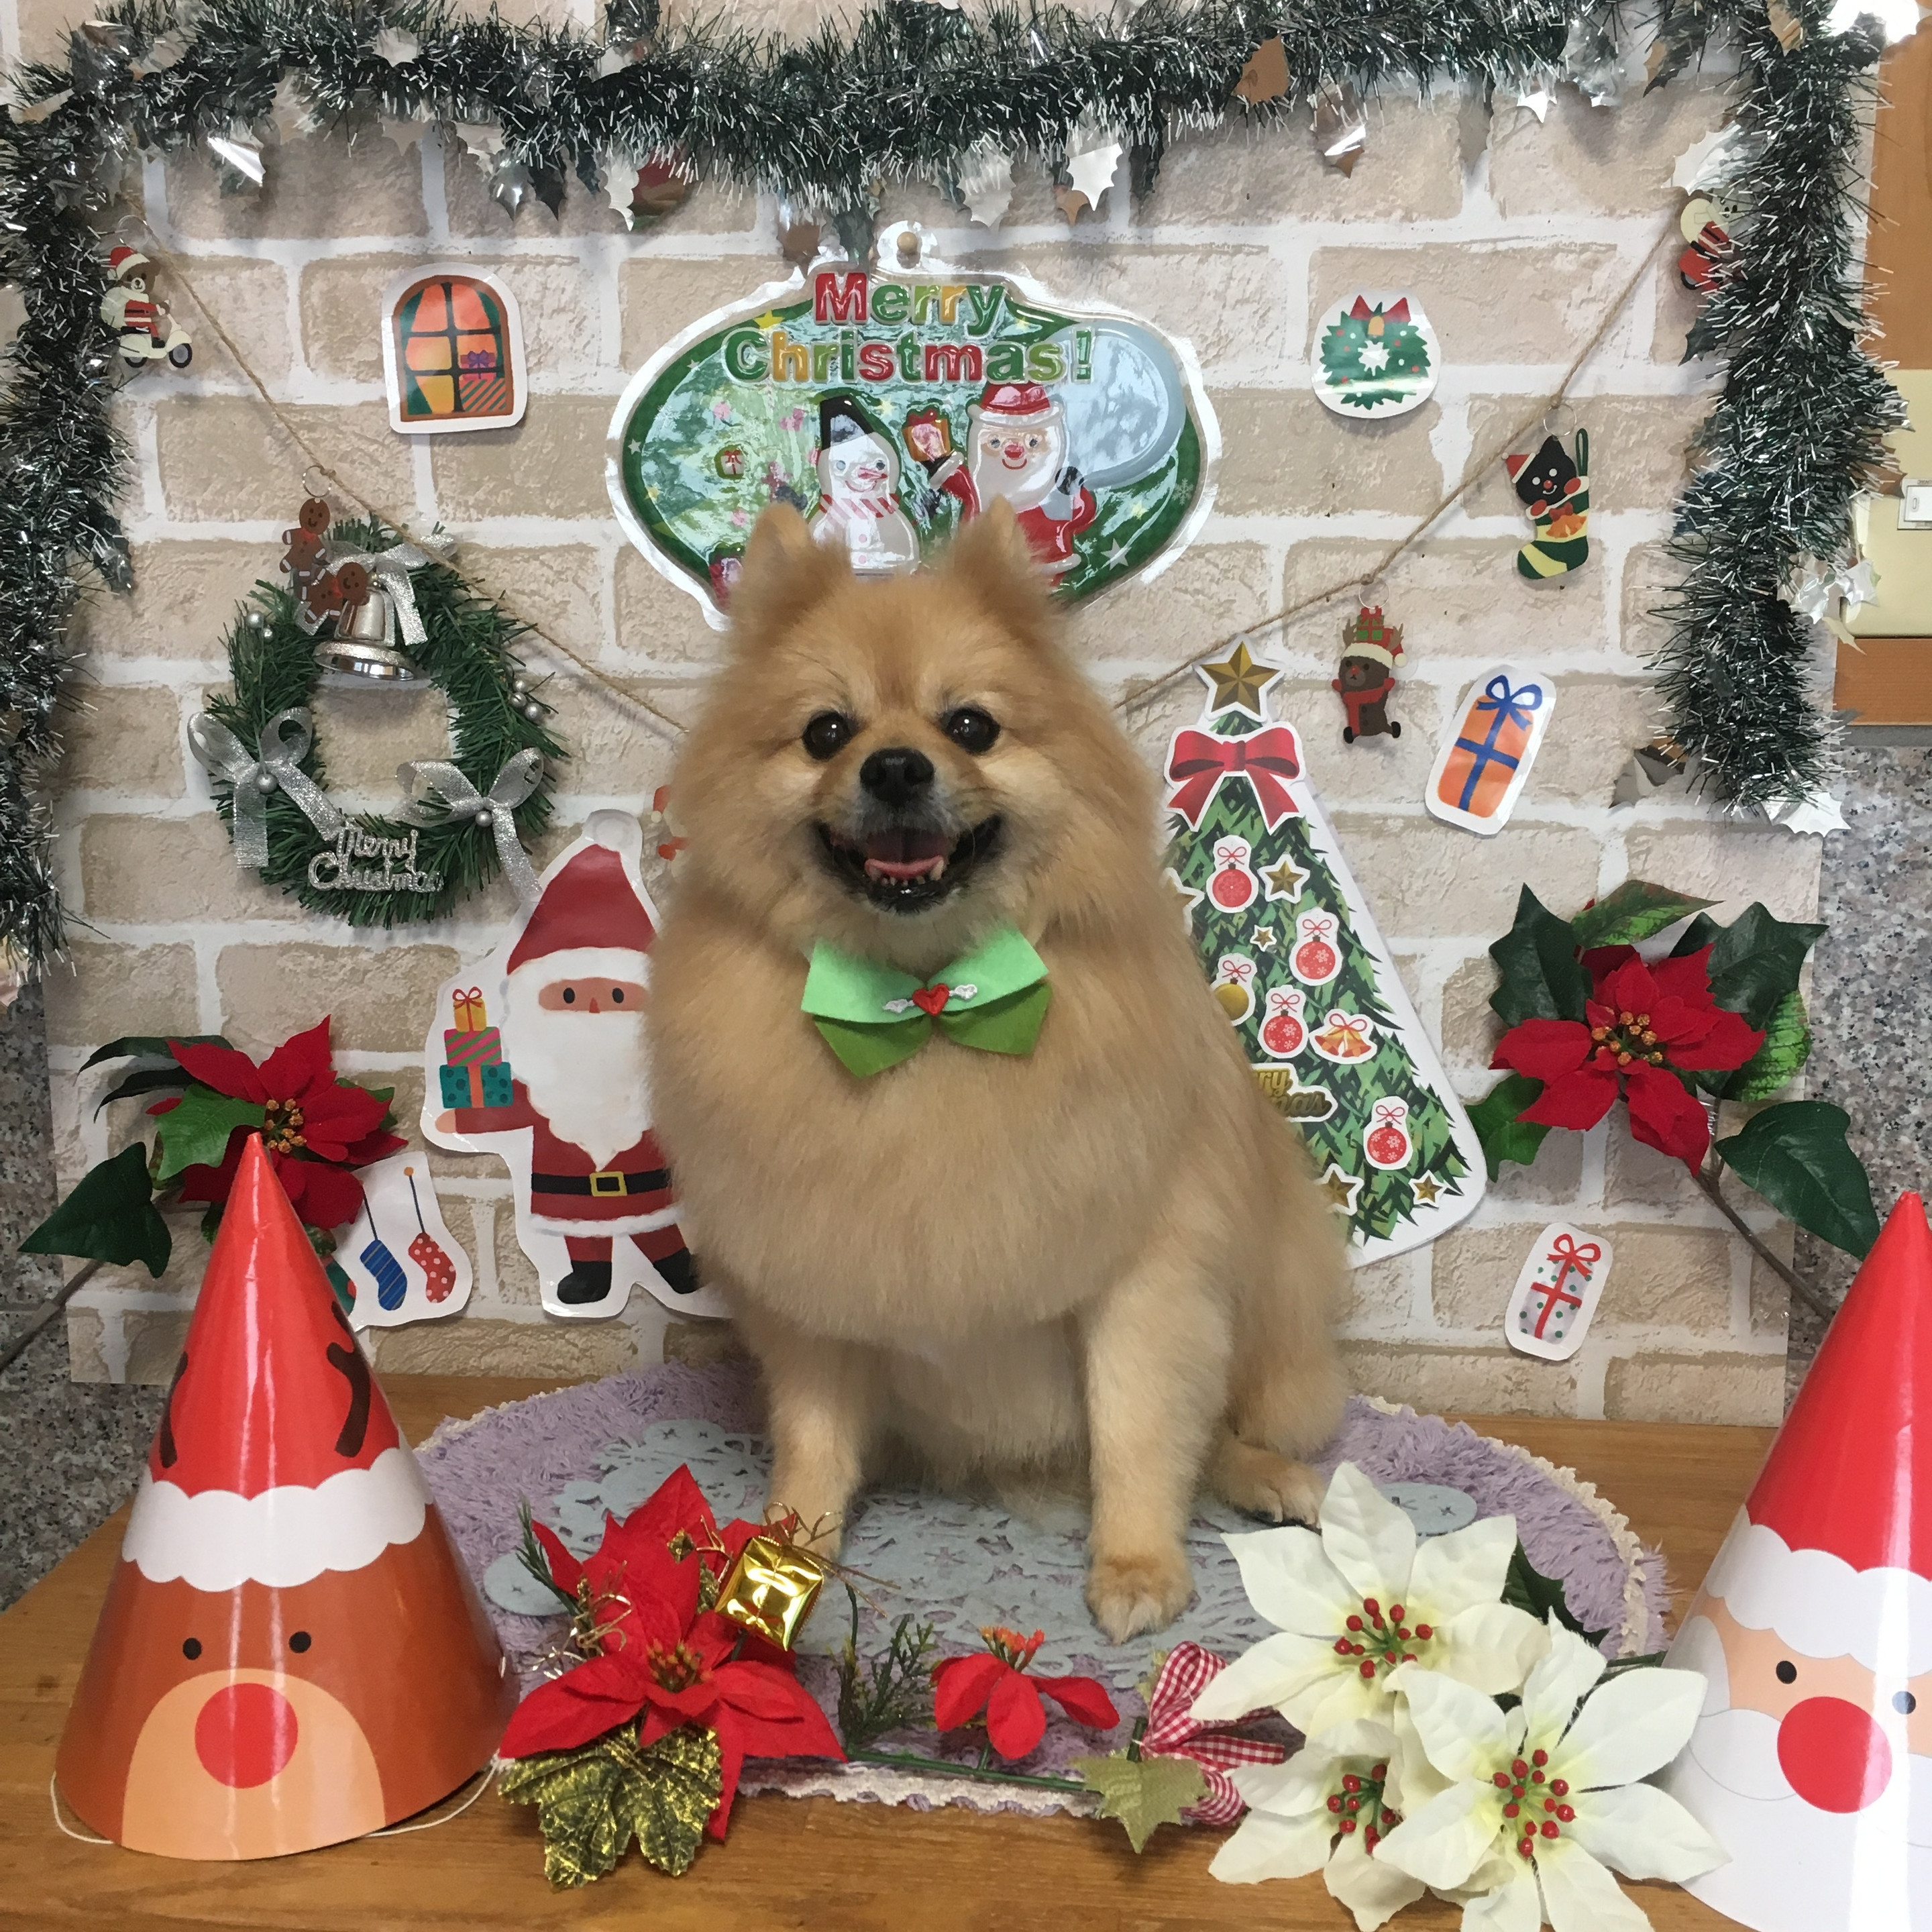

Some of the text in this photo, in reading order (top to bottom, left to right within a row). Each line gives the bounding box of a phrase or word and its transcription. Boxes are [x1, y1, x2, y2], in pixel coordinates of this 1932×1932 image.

[812, 271, 1008, 336] Merry
[724, 328, 1094, 384] Christmas!
[337, 818, 419, 873] Merry
